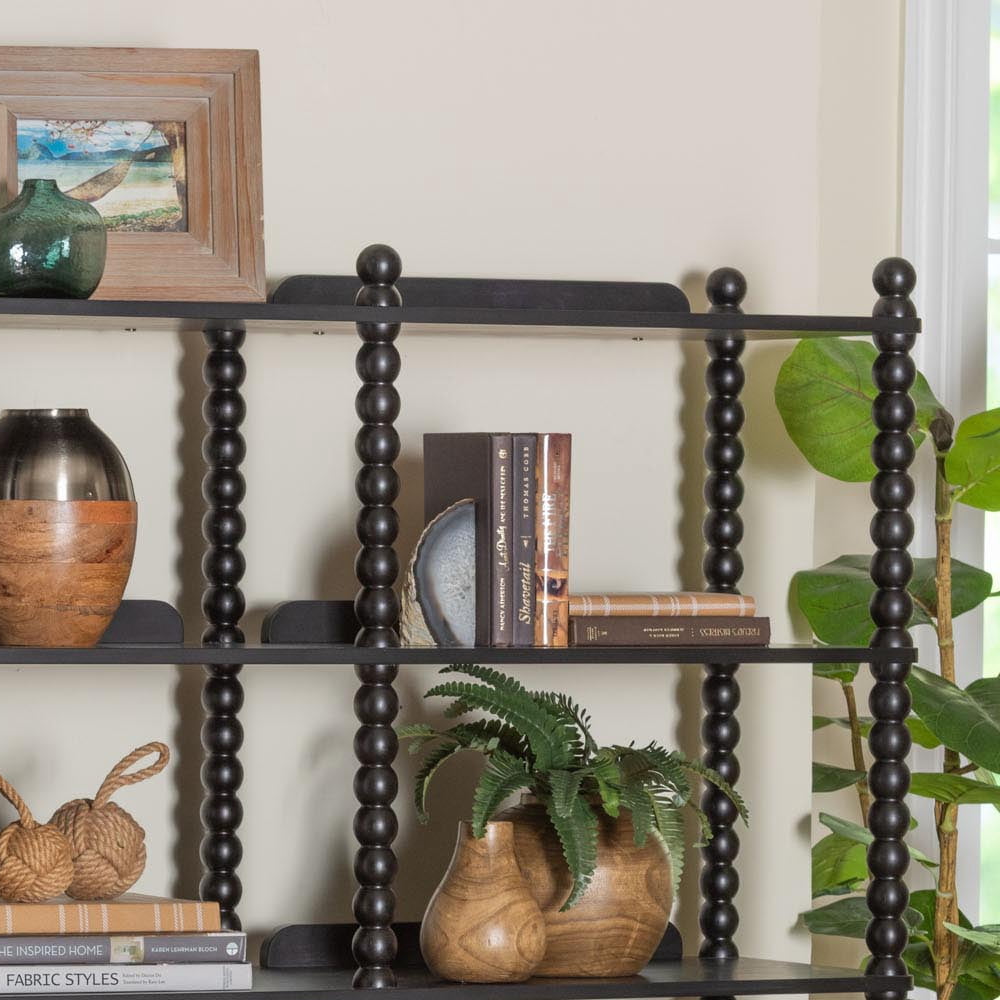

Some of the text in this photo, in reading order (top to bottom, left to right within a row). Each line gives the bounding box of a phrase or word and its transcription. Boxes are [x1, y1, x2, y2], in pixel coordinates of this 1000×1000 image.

[518, 562, 531, 625] Shavetail
[16, 945, 66, 956] INSPIRED
[69, 944, 104, 956] HOME
[6, 972, 119, 986] FABRIC STYLES
